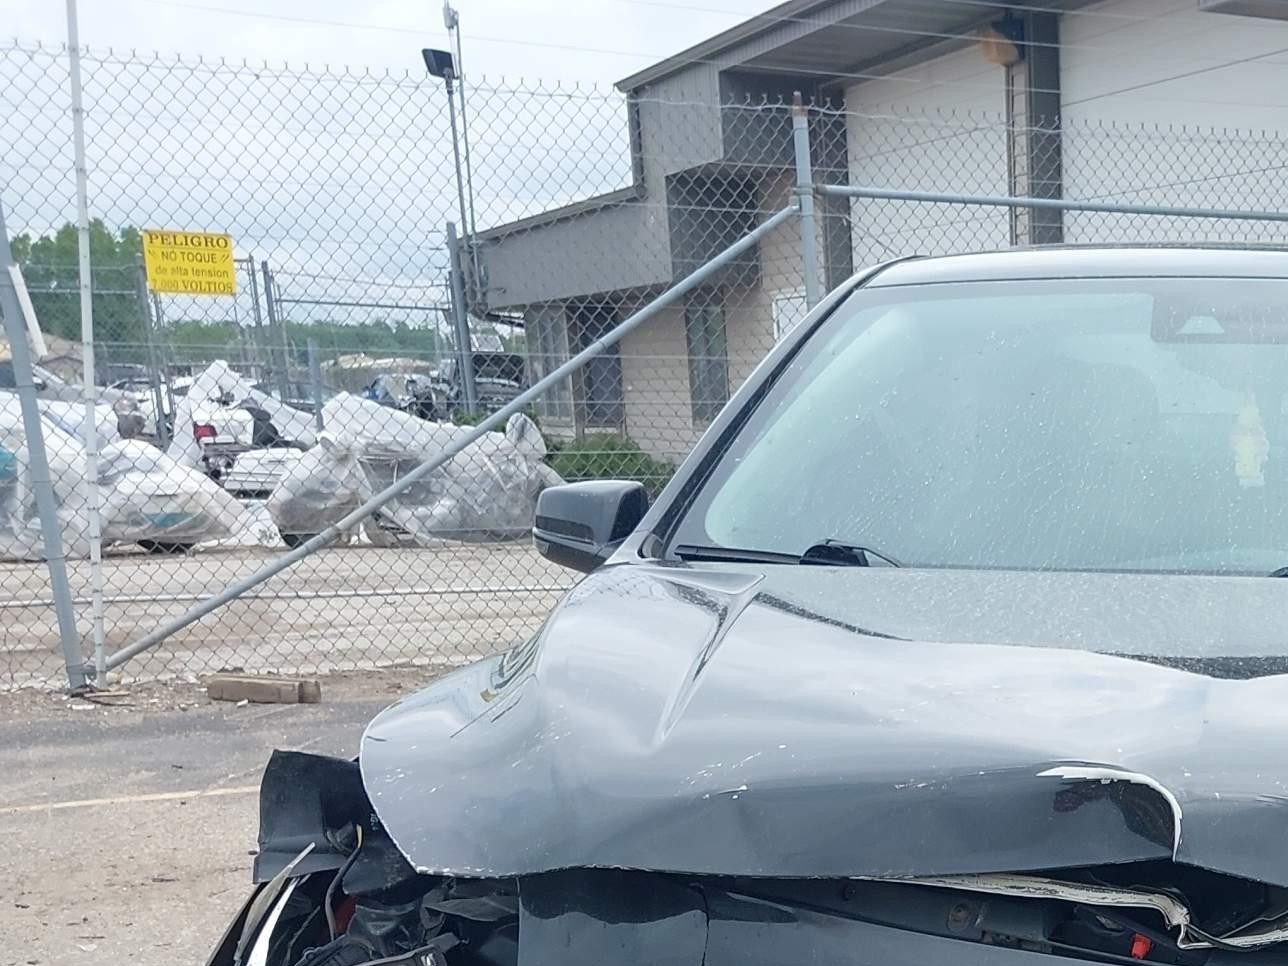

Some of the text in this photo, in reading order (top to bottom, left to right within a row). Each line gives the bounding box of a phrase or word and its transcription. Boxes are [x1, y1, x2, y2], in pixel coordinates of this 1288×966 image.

[149, 233, 228, 248] PELIGRO
[181, 252, 217, 264] TOQUE
[155, 266, 168, 275] de
[181, 279, 233, 293] VOLTIOS
